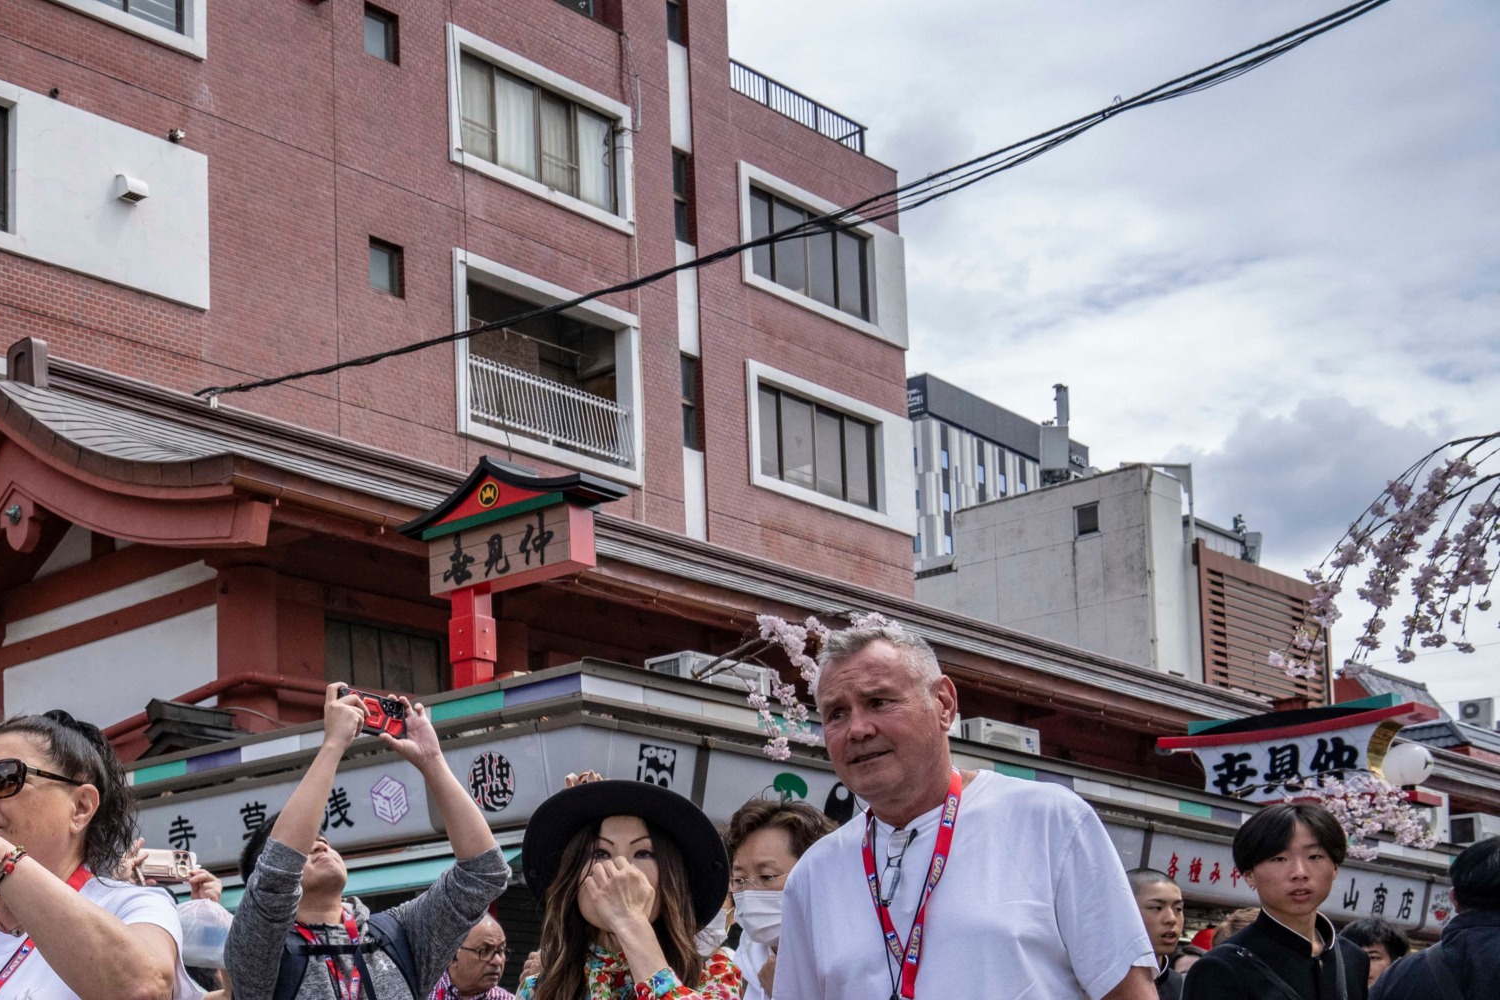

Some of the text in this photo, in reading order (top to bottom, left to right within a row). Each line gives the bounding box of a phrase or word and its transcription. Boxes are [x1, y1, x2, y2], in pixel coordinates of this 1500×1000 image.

[1342, 877, 1415, 921] 山商店
[0, 945, 32, 979] GATE1
[907, 924, 924, 965] GATE1
